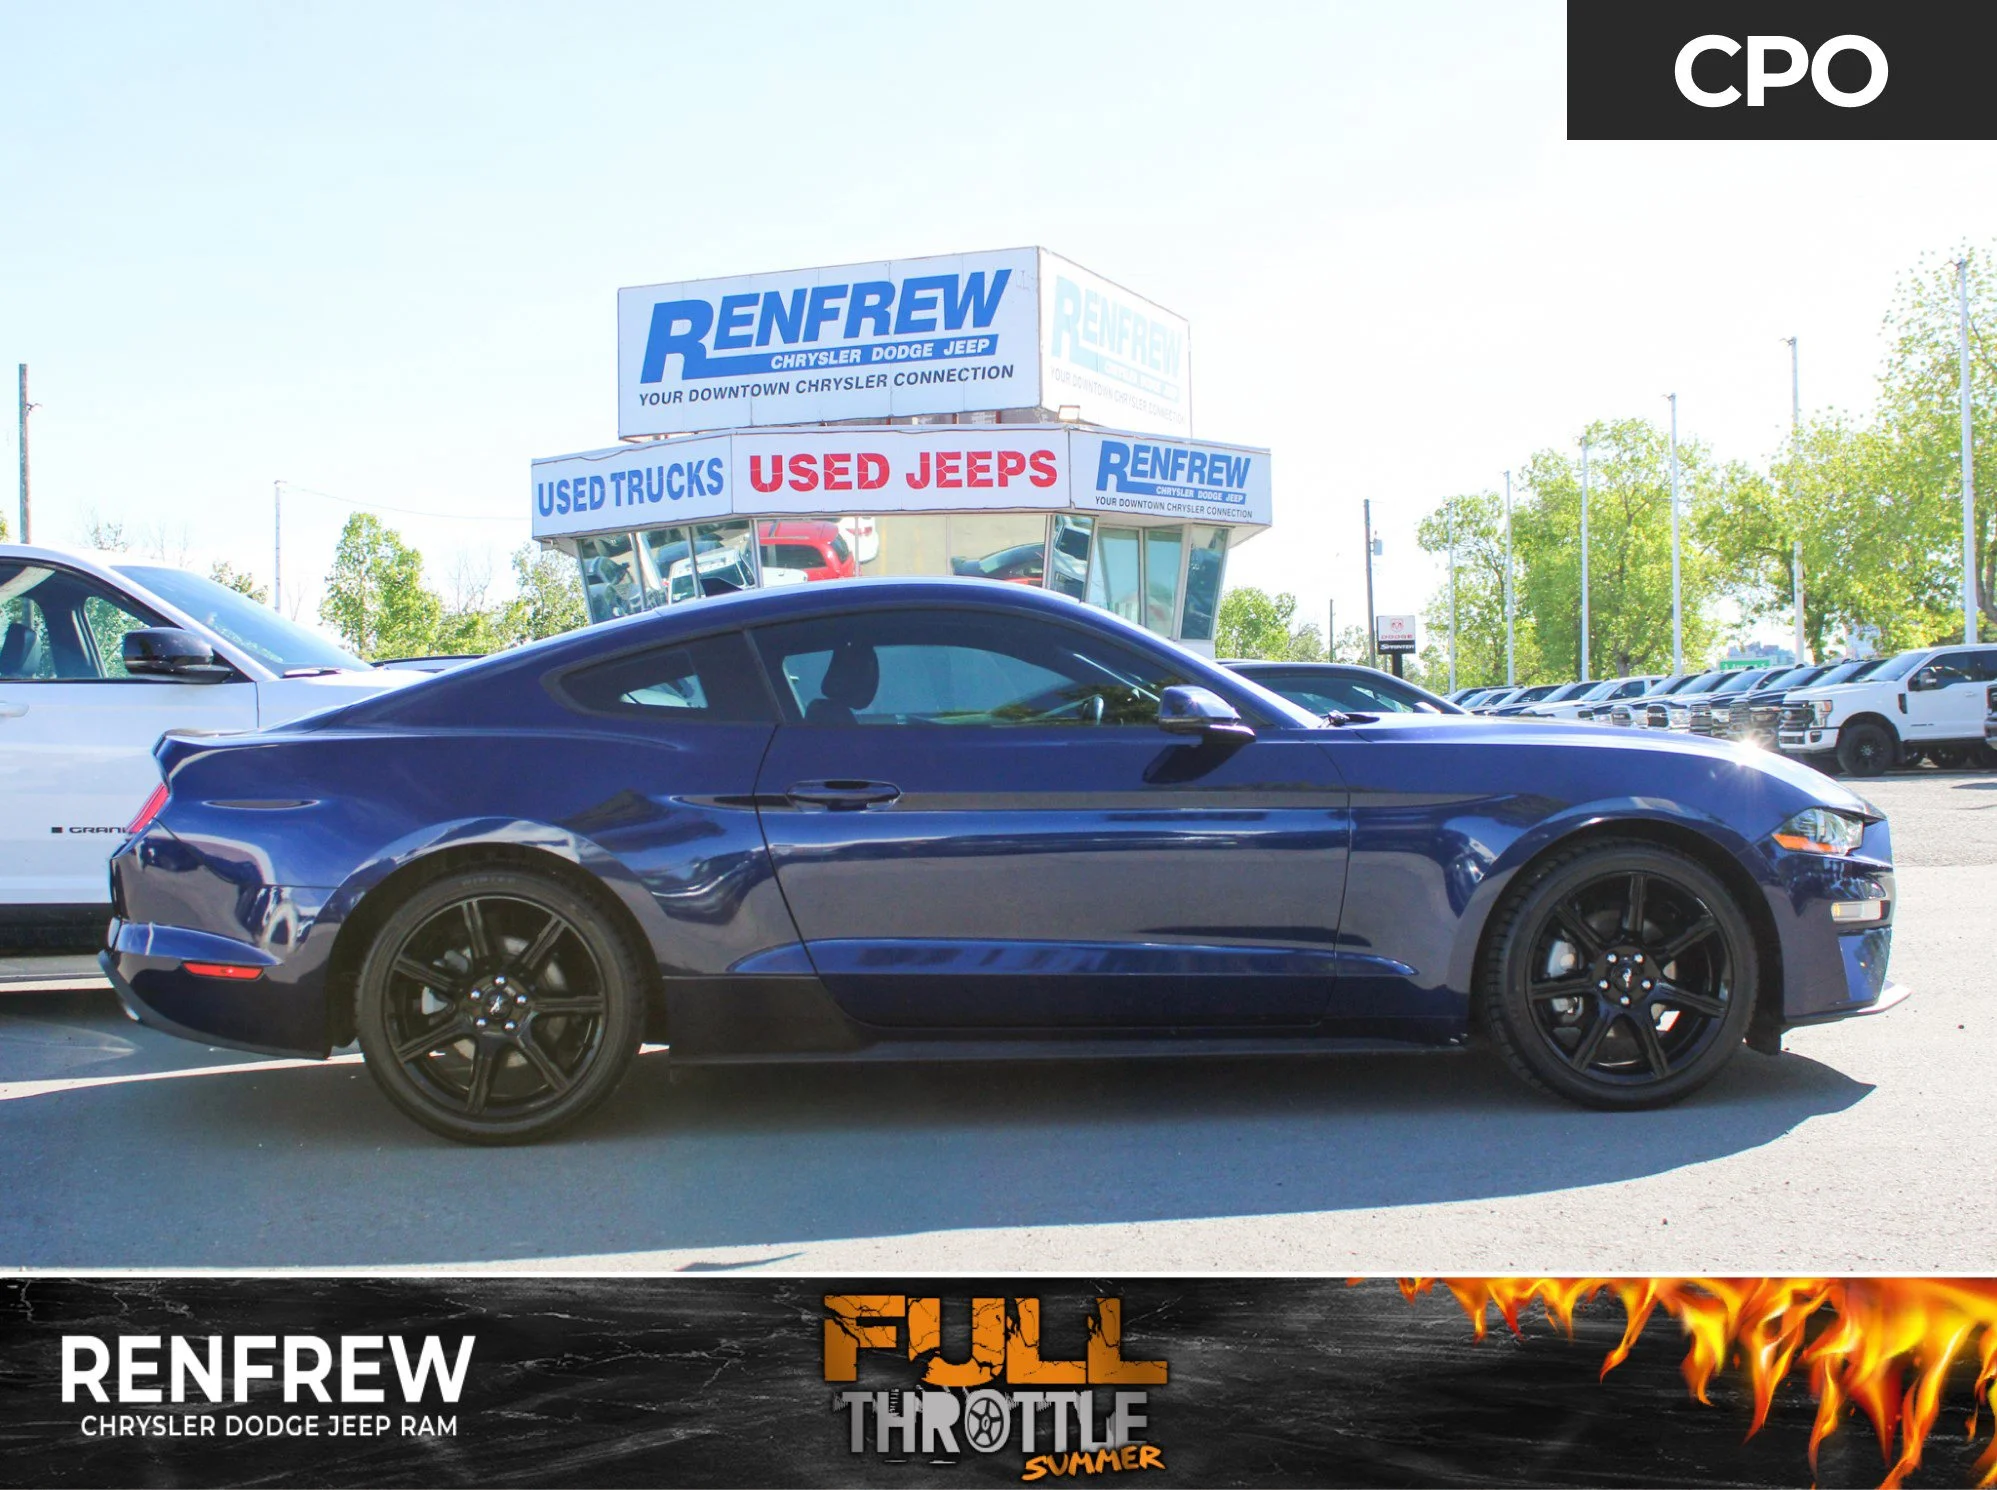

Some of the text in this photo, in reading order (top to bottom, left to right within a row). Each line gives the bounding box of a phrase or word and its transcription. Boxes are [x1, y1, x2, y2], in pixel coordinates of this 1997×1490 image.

[640, 268, 1012, 384] RENFREW
[1050, 274, 1183, 380] RENFREW
[770, 338, 991, 370] CHRYSLER DODGE JEEP
[639, 364, 1015, 407] YOUR DOWNTOWN CHRYSLER CONNECTION
[1050, 365, 1071, 385] YOUR
[1072, 374, 1114, 402] DOWNTOWN
[538, 457, 725, 518] USED TRUCKS
[749, 449, 1059, 494] USED JEEPS
[1096, 440, 1252, 492] RENFREW
[1095, 496, 1253, 519] YOUR DOWNTOWN CHRYSLER CONNECTION
[1155, 486, 1244, 504] CHRYSLER DODGE JEEP
